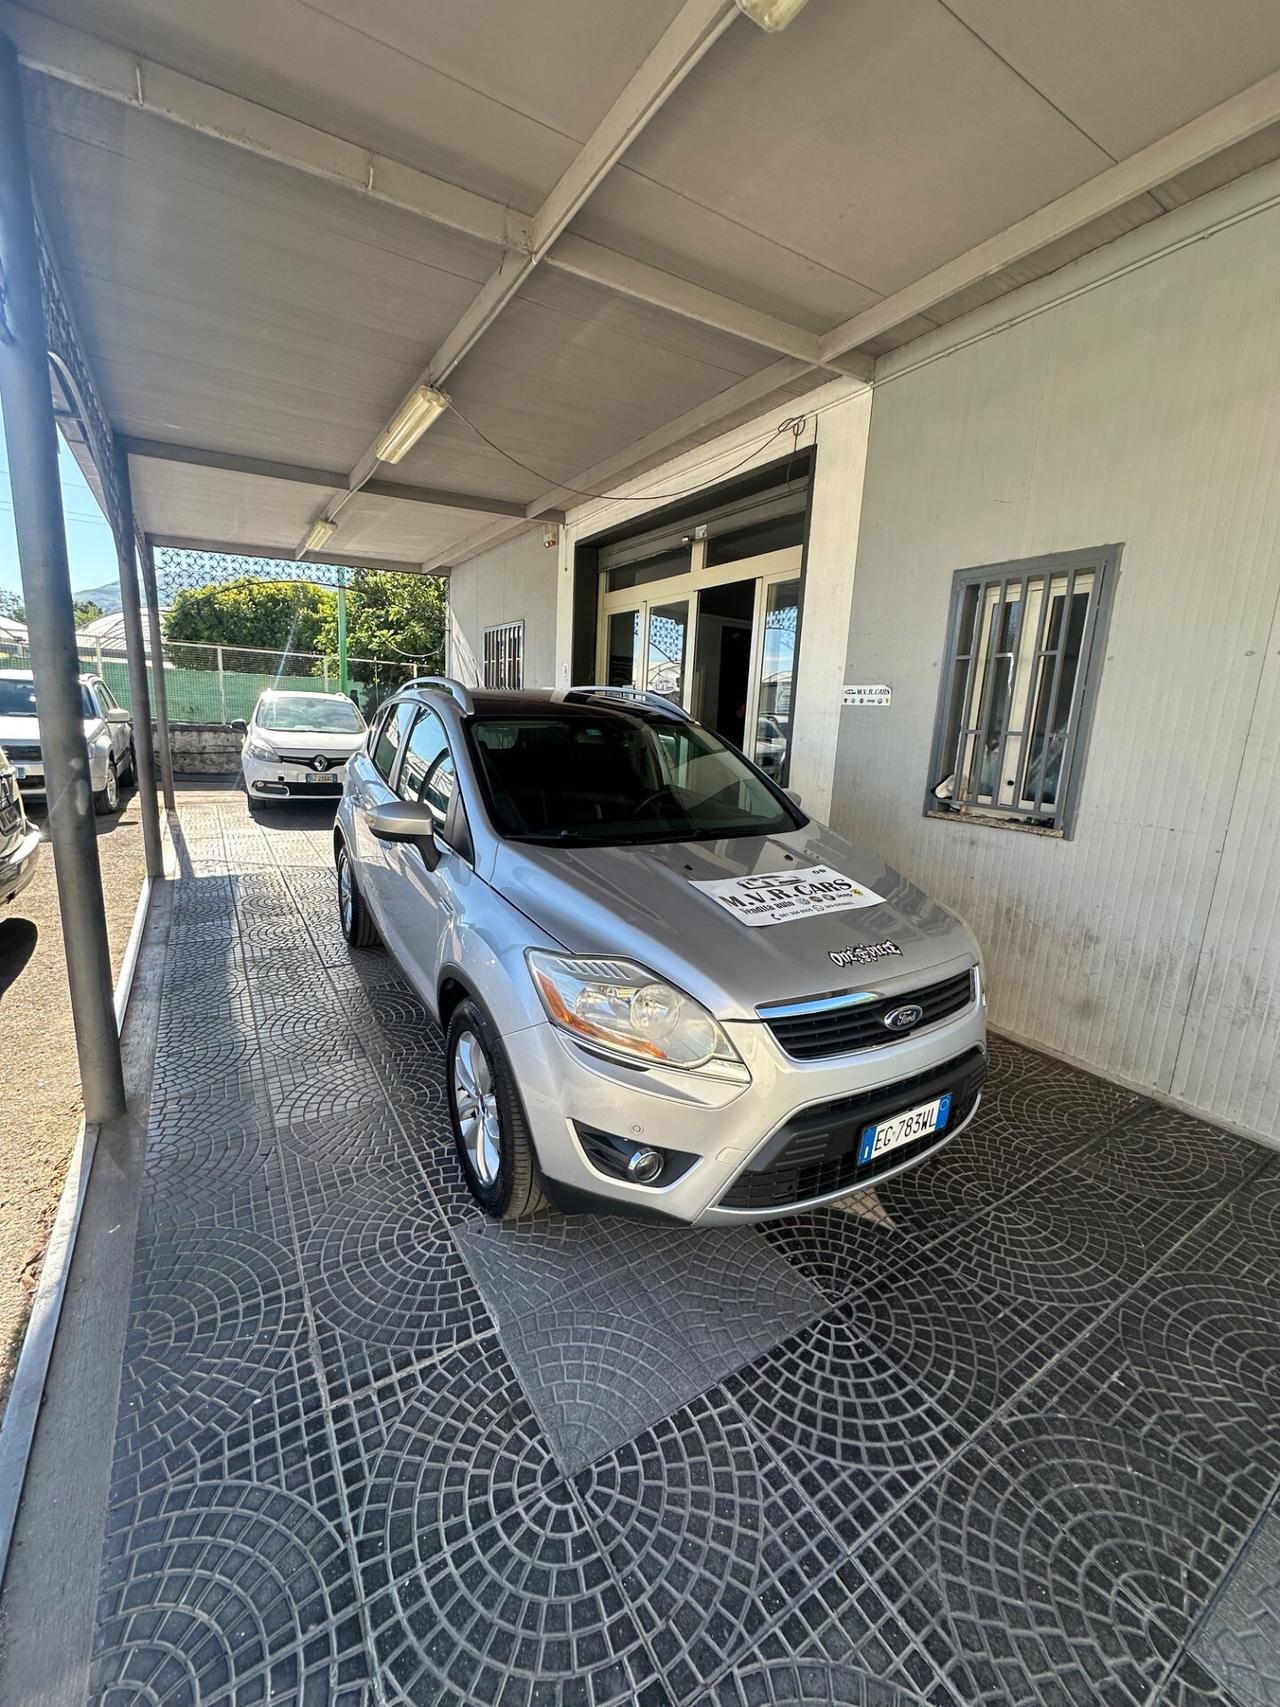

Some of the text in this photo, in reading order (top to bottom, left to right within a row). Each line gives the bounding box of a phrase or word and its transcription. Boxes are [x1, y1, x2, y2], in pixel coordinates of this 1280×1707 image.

[739, 900, 795, 915] Vendita auto
[897, 1009, 917, 1026] Ford
